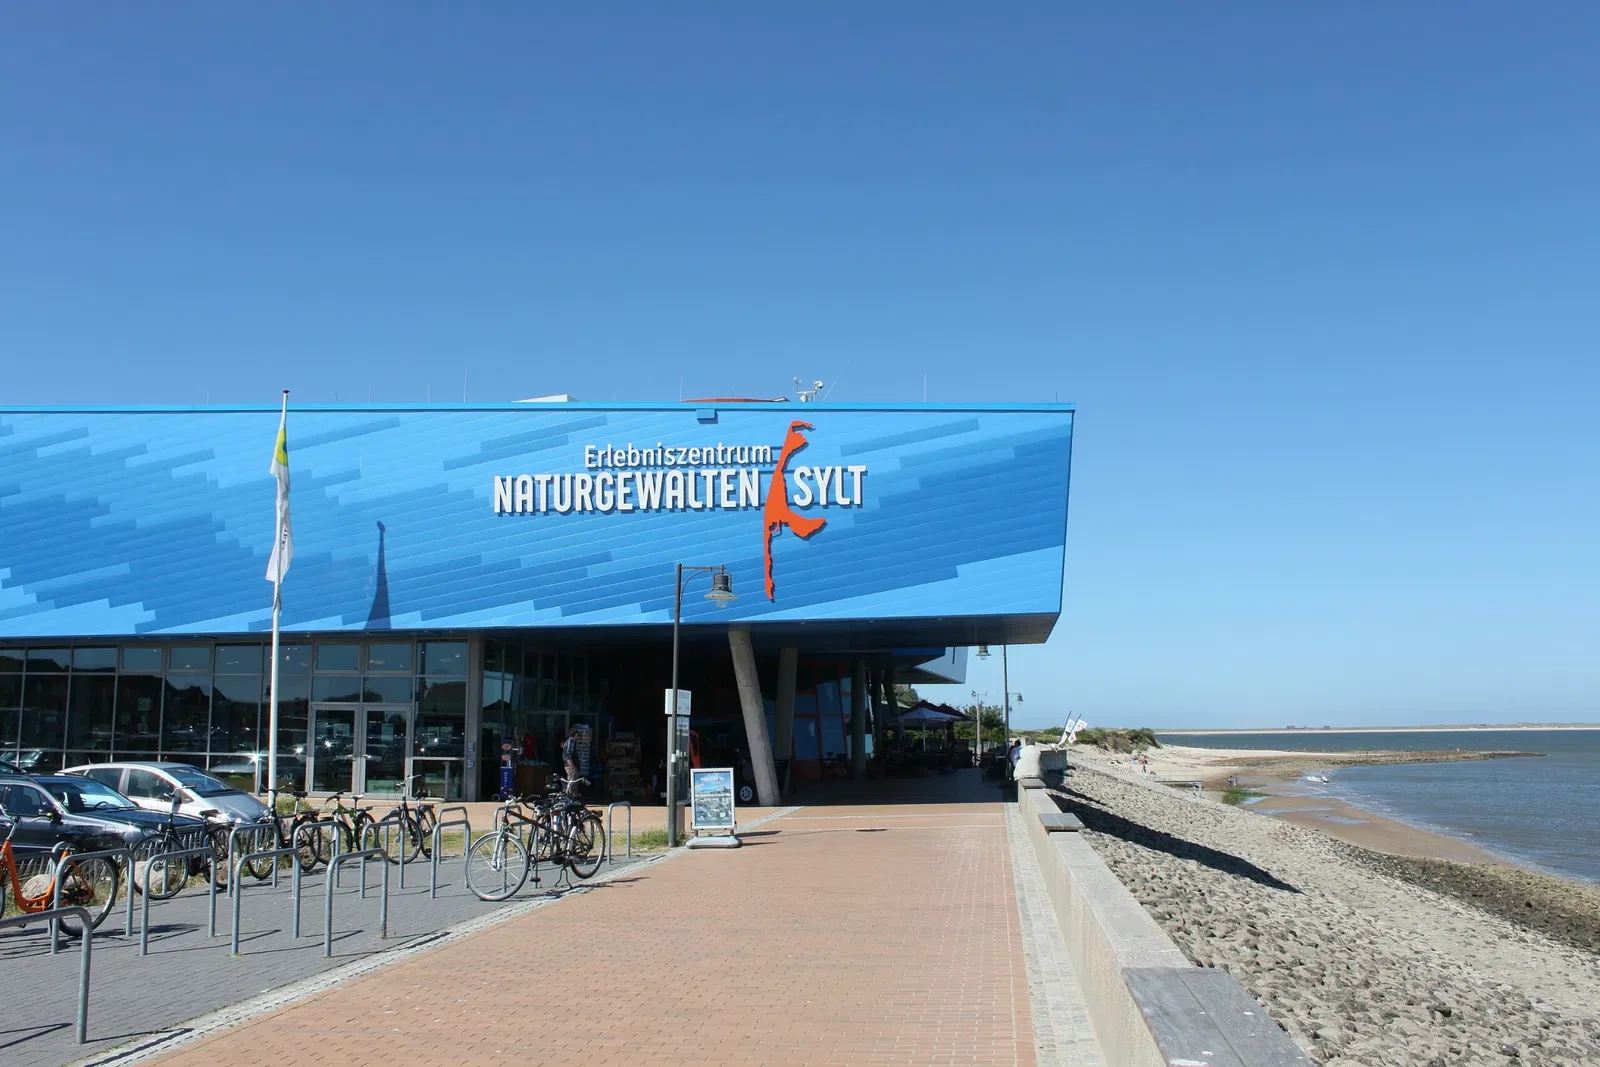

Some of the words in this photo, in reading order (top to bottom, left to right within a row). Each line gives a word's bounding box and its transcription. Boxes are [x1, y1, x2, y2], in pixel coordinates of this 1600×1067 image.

[584, 442, 772, 468] Erlebniszentrum
[494, 468, 759, 513] NATURGEWALTEN
[793, 465, 867, 507] SYLT
